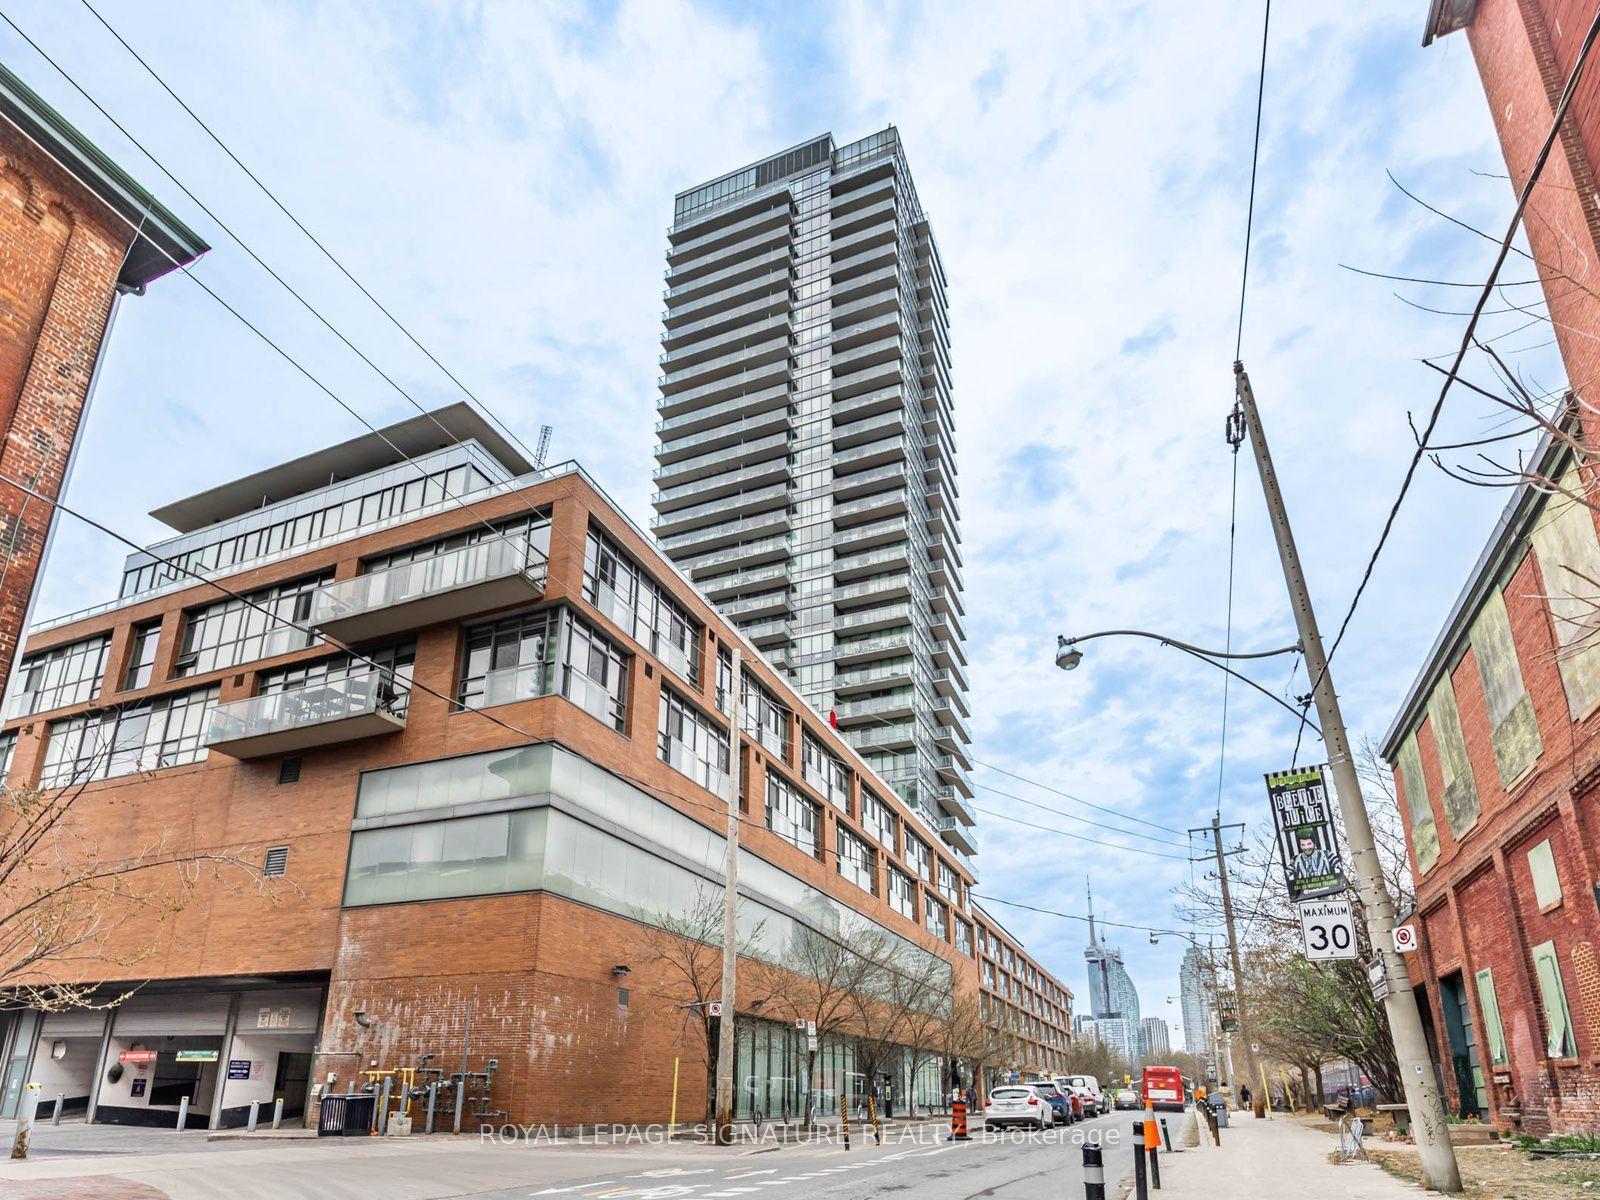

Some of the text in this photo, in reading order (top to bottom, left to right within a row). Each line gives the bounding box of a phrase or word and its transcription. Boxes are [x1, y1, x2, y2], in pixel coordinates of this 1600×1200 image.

[1275, 786, 1323, 810] BEETLE
[1303, 906, 1347, 917] MAXIMUM
[1310, 924, 1350, 951] 30
